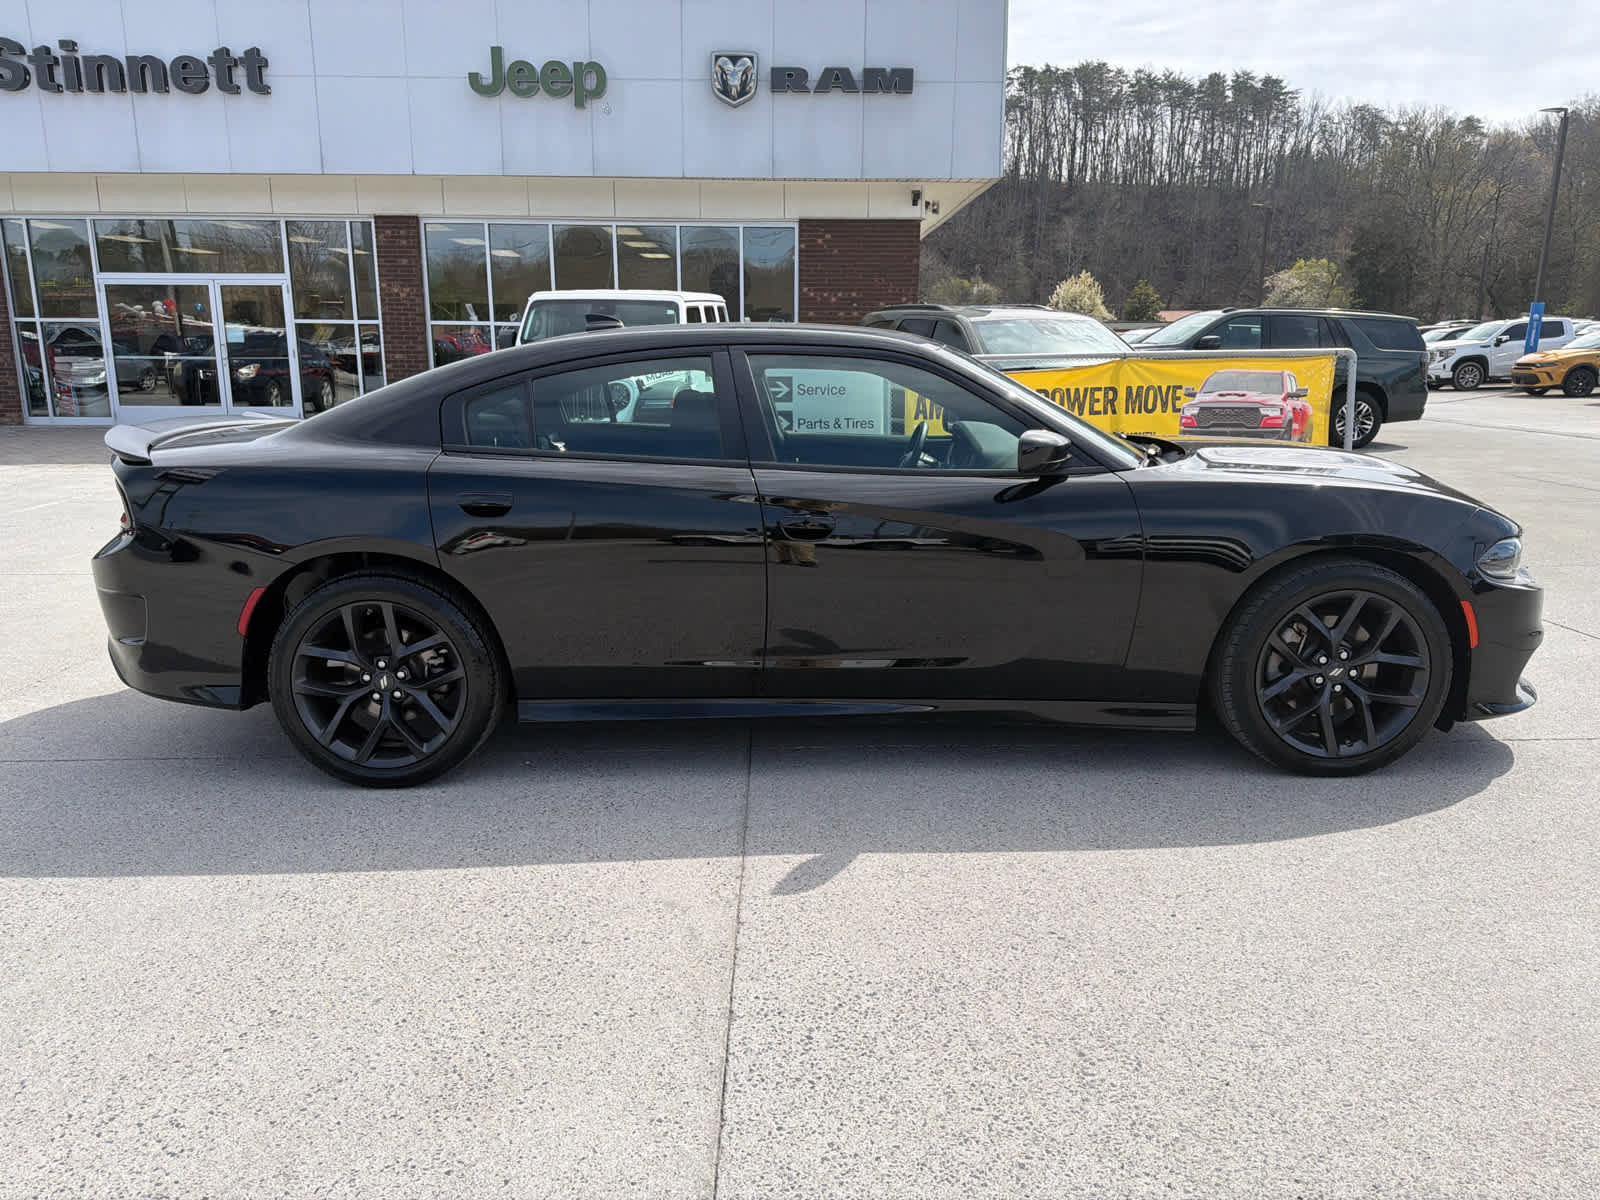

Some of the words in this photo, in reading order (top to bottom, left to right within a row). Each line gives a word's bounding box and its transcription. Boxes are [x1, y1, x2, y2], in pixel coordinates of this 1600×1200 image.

[0, 37, 271, 95] Stinnett
[468, 46, 608, 109] Jeep
[771, 66, 914, 94] RAM
[797, 383, 846, 396] Service
[1125, 385, 1184, 414] MOVE
[797, 418, 830, 429] Parts
[833, 418, 842, 429] &
[844, 418, 874, 429] Tires
